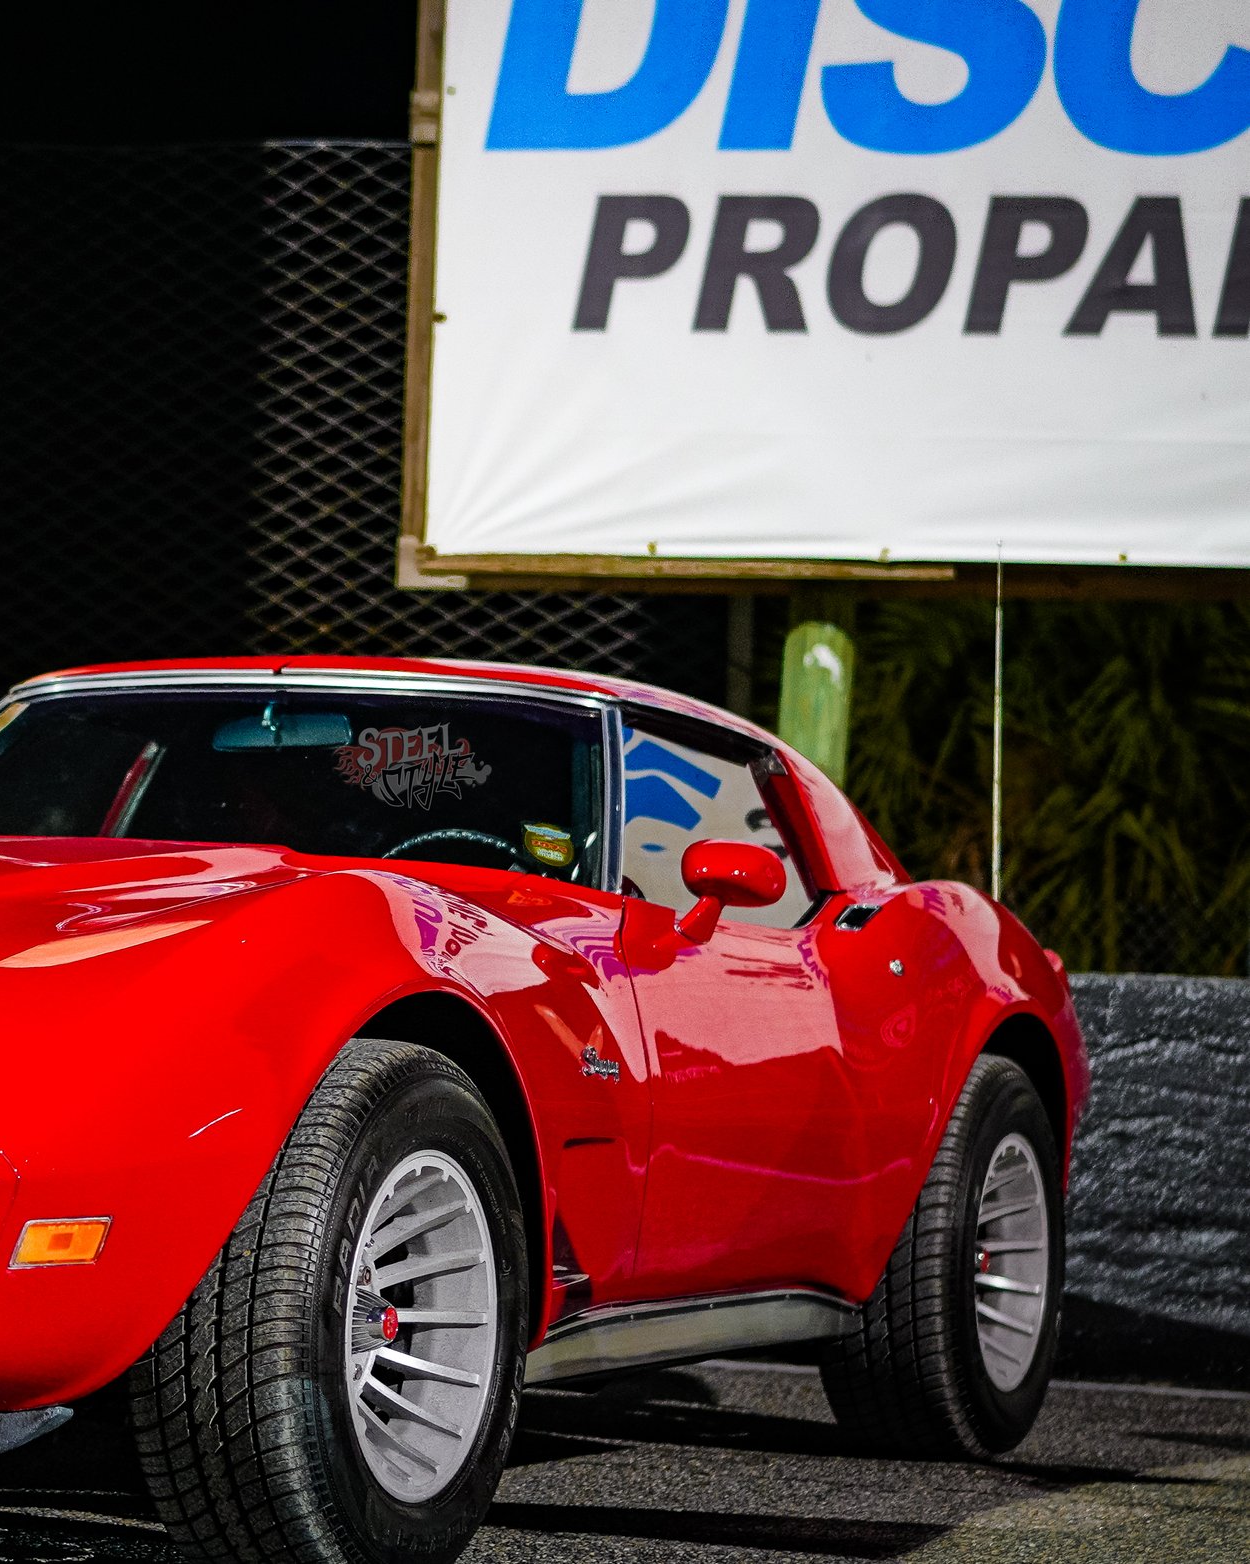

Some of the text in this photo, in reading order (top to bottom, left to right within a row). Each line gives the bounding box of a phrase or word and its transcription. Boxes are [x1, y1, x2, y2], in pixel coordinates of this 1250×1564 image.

[356, 722, 465, 771] STEEL
[360, 752, 476, 812] & STYLE
